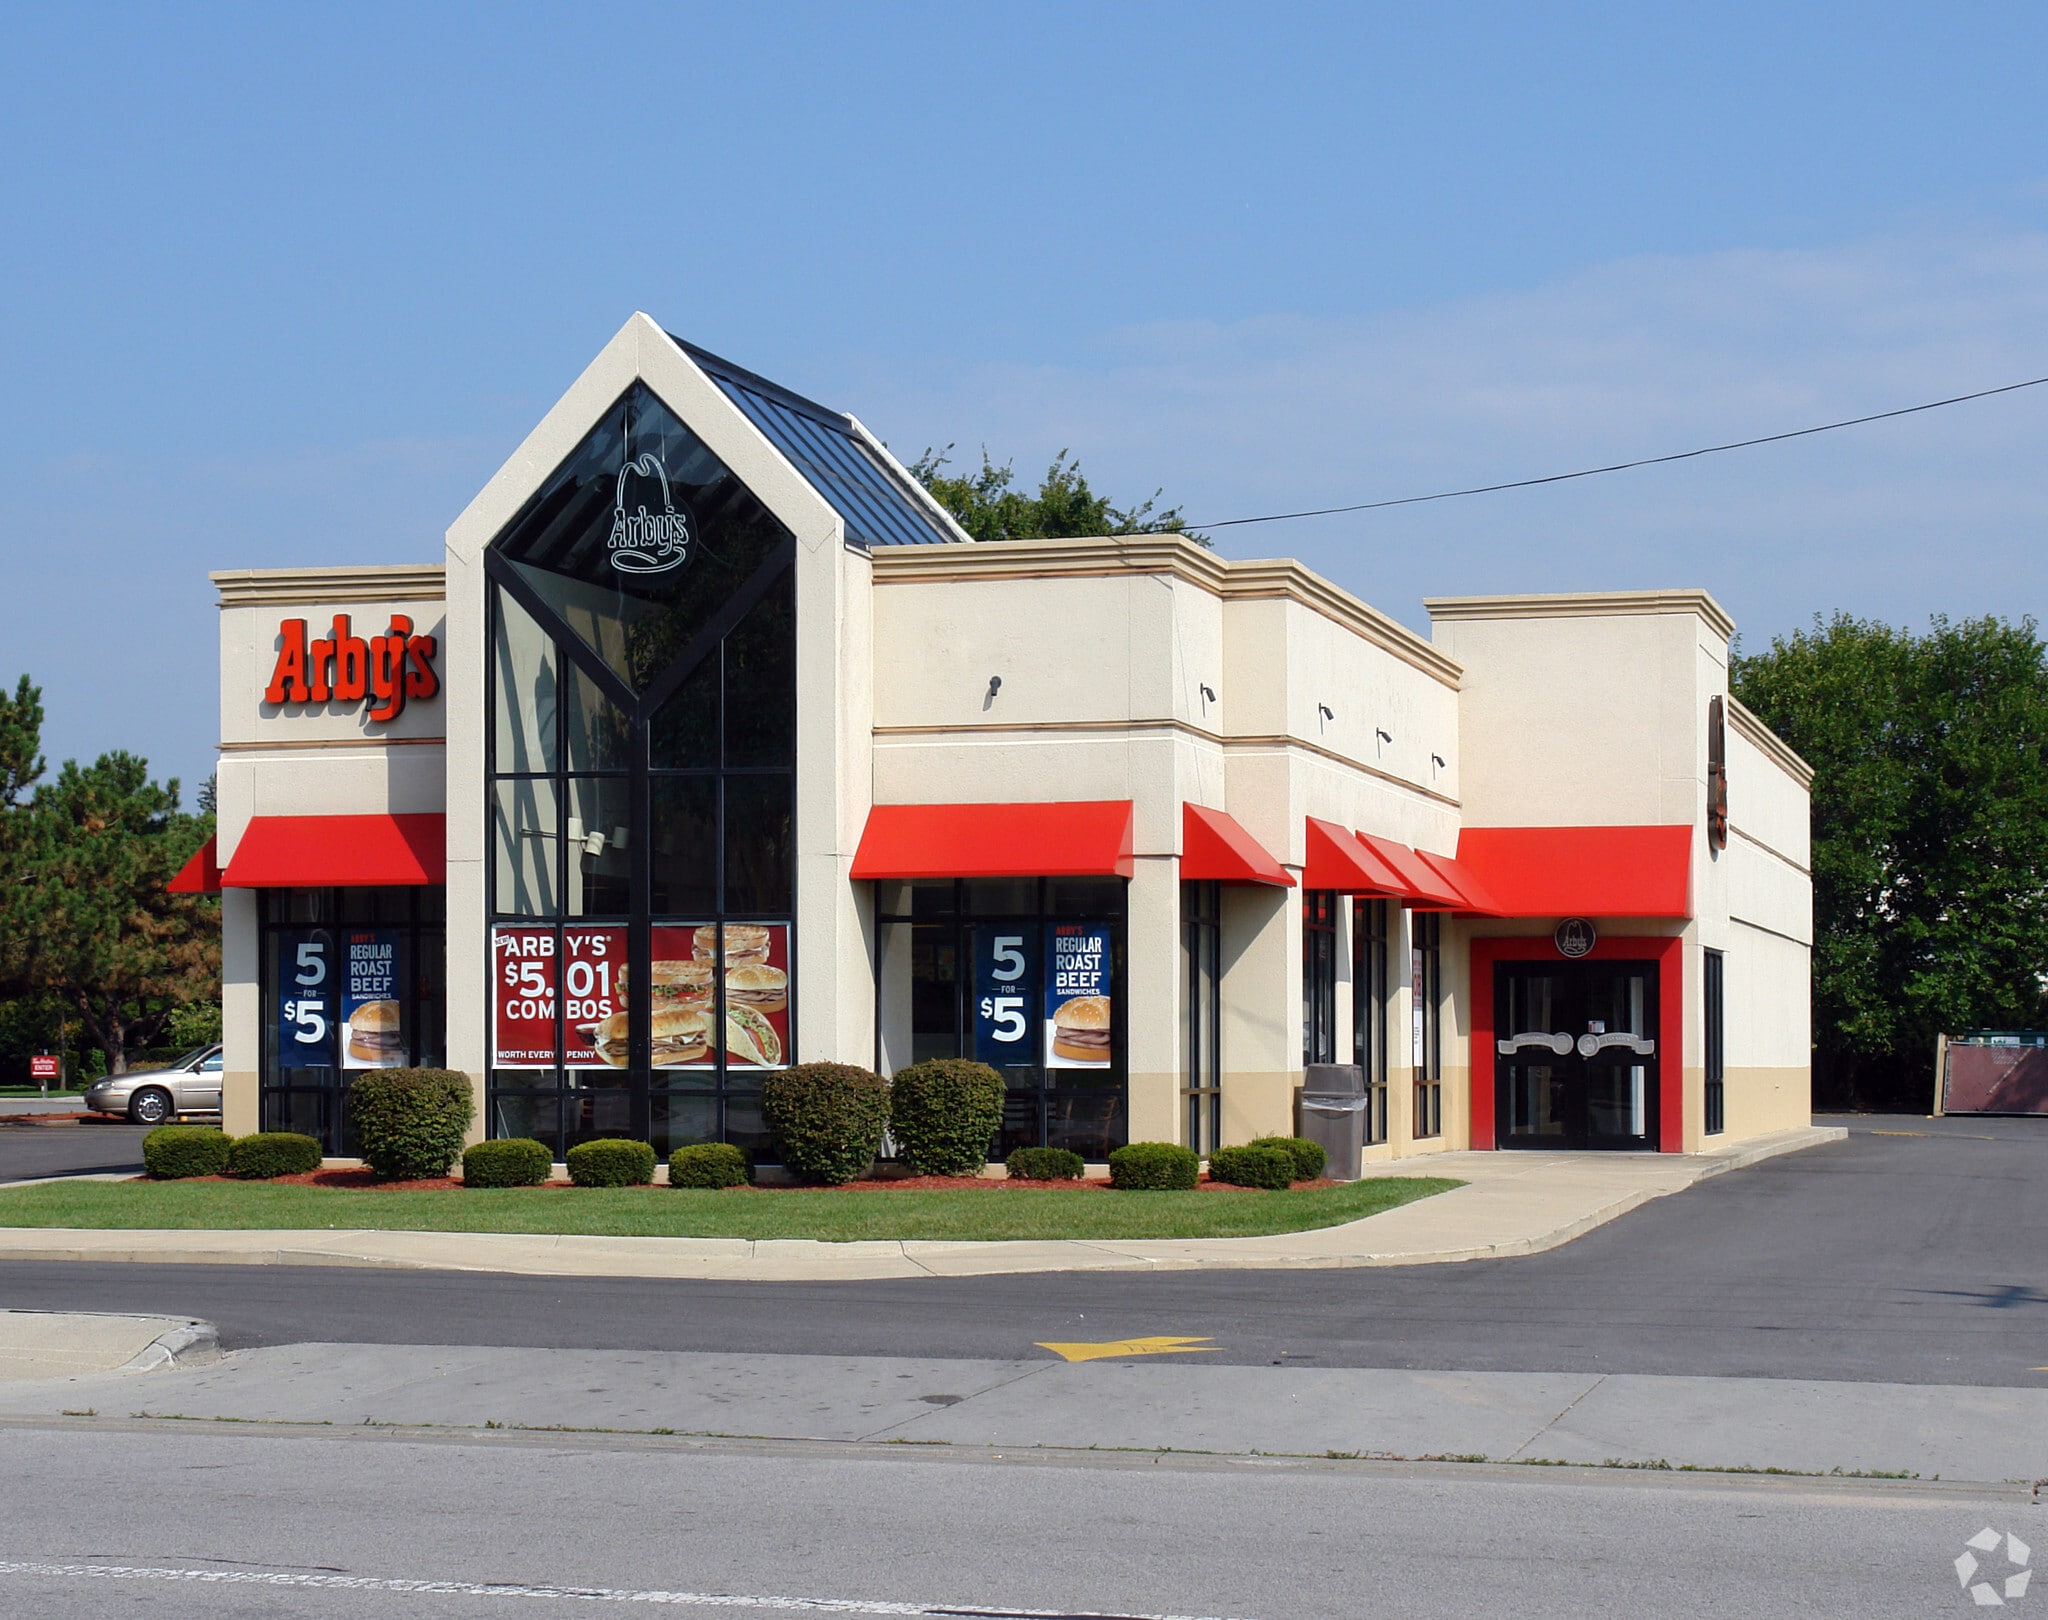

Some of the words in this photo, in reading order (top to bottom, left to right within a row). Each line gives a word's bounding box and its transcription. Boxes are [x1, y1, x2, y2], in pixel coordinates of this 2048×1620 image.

[607, 505, 689, 555] Arby's
[265, 613, 438, 721] Arby's
[350, 944, 392, 960] REGULAR
[1056, 936, 1102, 953] REGULAR
[295, 943, 326, 985] 5
[991, 936, 1025, 981] 5
[1056, 954, 1102, 970] ROAST
[350, 960, 392, 976] ROAST
[351, 977, 393, 992] BEEF
[1056, 971, 1102, 987] BEEF
[303, 989, 317, 998] FOR
[1001, 985, 1016, 994] FOR
[1056, 988, 1101, 996] SANDWICHES
[284, 1000, 326, 1043] $5
[980, 997, 1026, 1042] $5
[498, 1050, 526, 1059] WORTH
[528, 1050, 555, 1059] EVERY
[566, 1050, 595, 1059] PENNY
